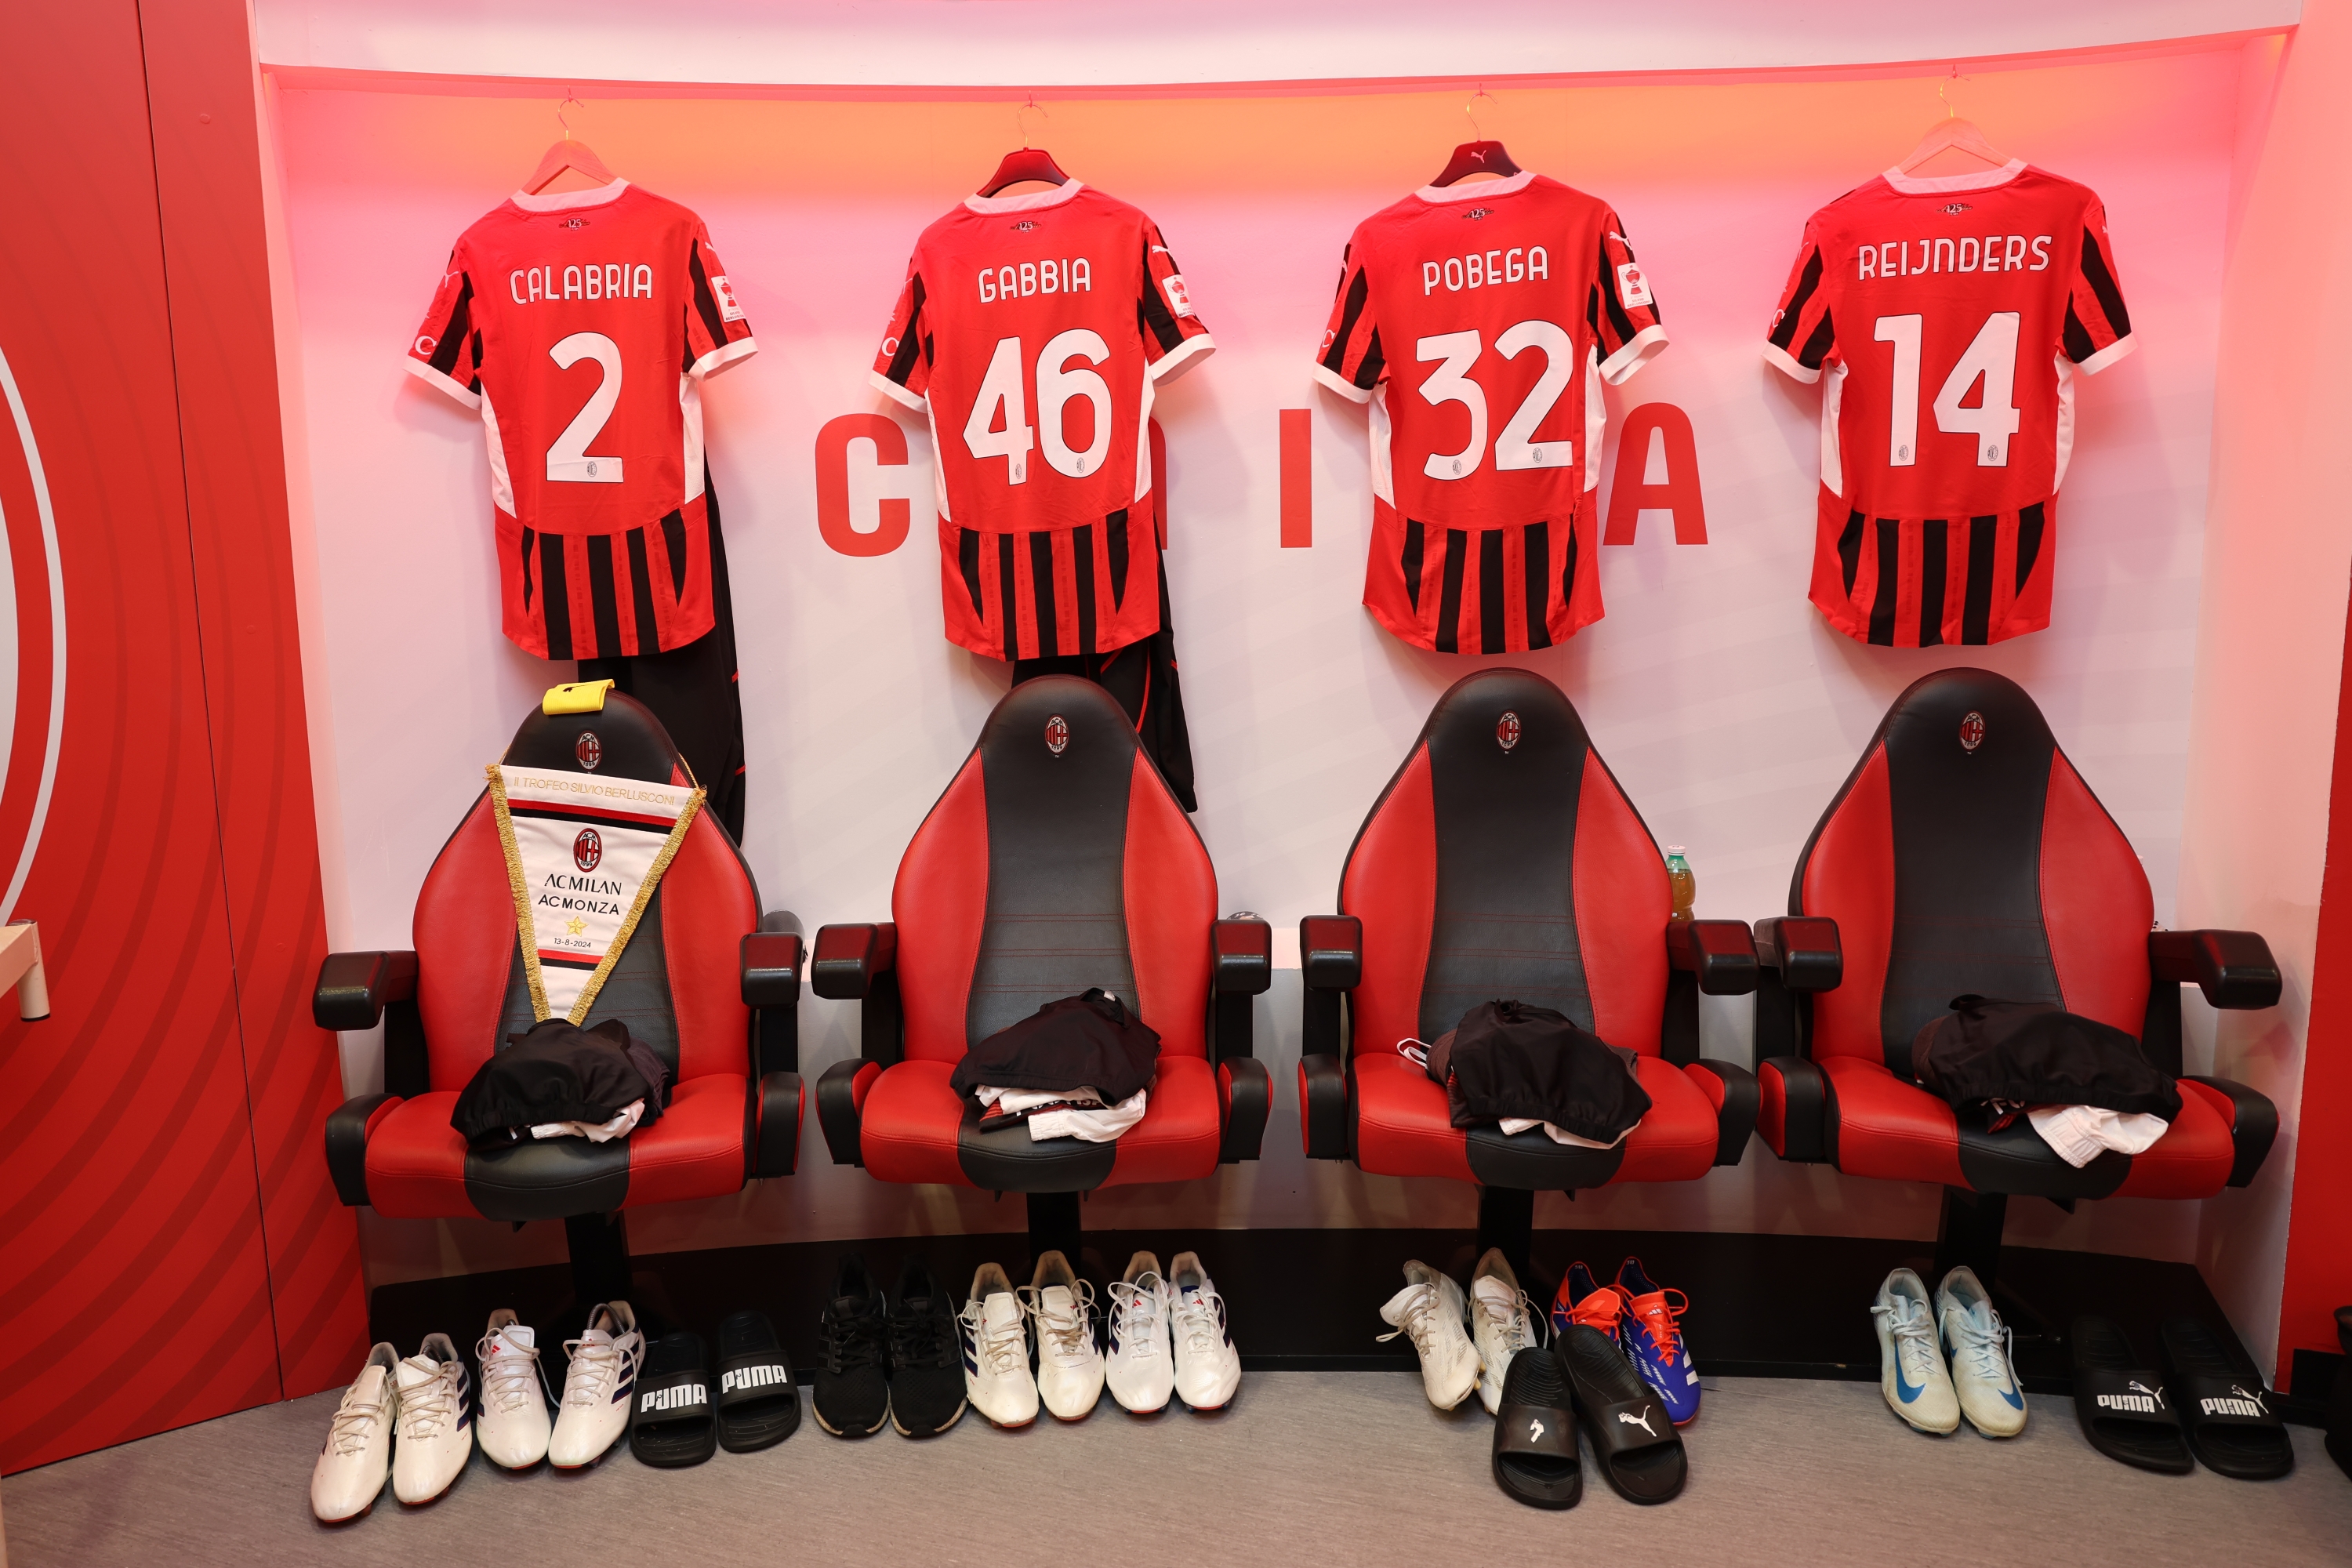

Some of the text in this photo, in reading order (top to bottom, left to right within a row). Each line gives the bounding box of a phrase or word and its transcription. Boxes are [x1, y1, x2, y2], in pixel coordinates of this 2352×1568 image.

[978, 257, 1092, 303] GABBIA
[1422, 245, 1549, 296] POBEGA
[1858, 235, 2053, 281] REIJNDERS
[510, 263, 653, 305] CALABRIA
[546, 332, 624, 483] 2
[963, 328, 1112, 486] 46
[1416, 319, 1573, 481] 32
[1873, 311, 2021, 467] 14
[522, 777, 569, 791] TROFEO
[570, 782, 604, 796] SILVIO
[604, 786, 675, 806] BERLUSCONI
[554, 938, 591, 948] 13-8-2024
[641, 1384, 707, 1413] PUMA
[721, 1365, 787, 1394] PUMA
[2096, 1395, 2155, 1413] PUMA
[2200, 1398, 2261, 1417] PUMA
